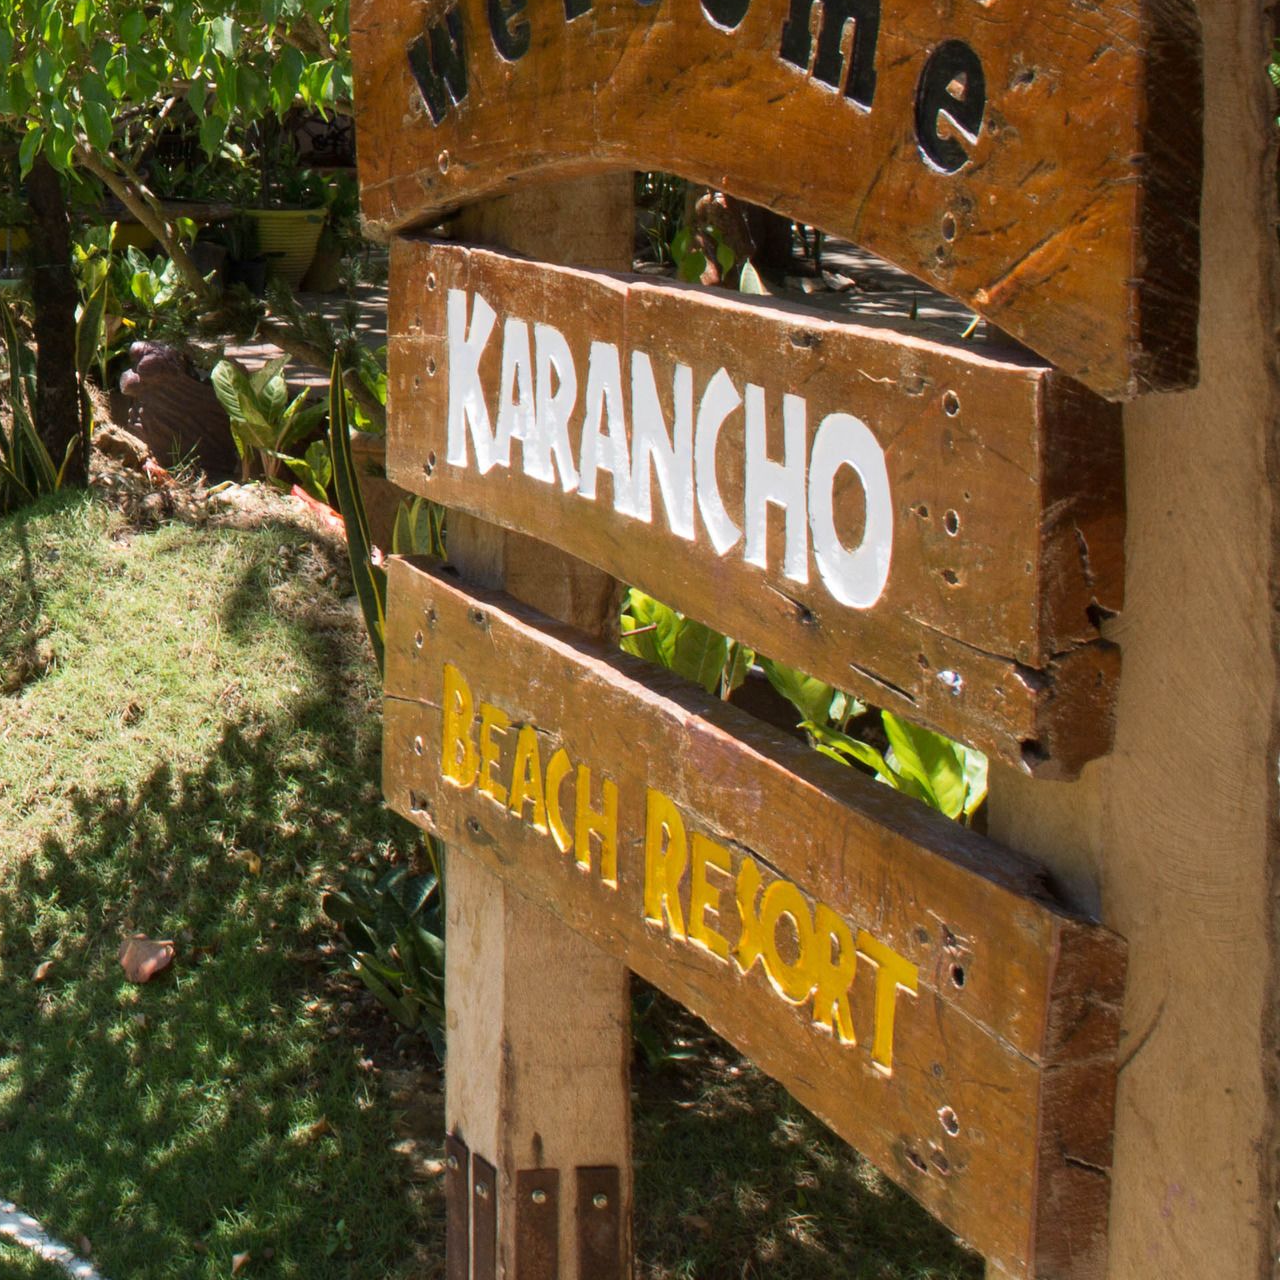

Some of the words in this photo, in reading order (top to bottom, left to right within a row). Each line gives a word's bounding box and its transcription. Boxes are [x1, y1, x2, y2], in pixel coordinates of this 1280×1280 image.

[446, 290, 893, 609] KARANCHO
[441, 664, 620, 890] BEACH
[644, 786, 918, 1076] RESORT
